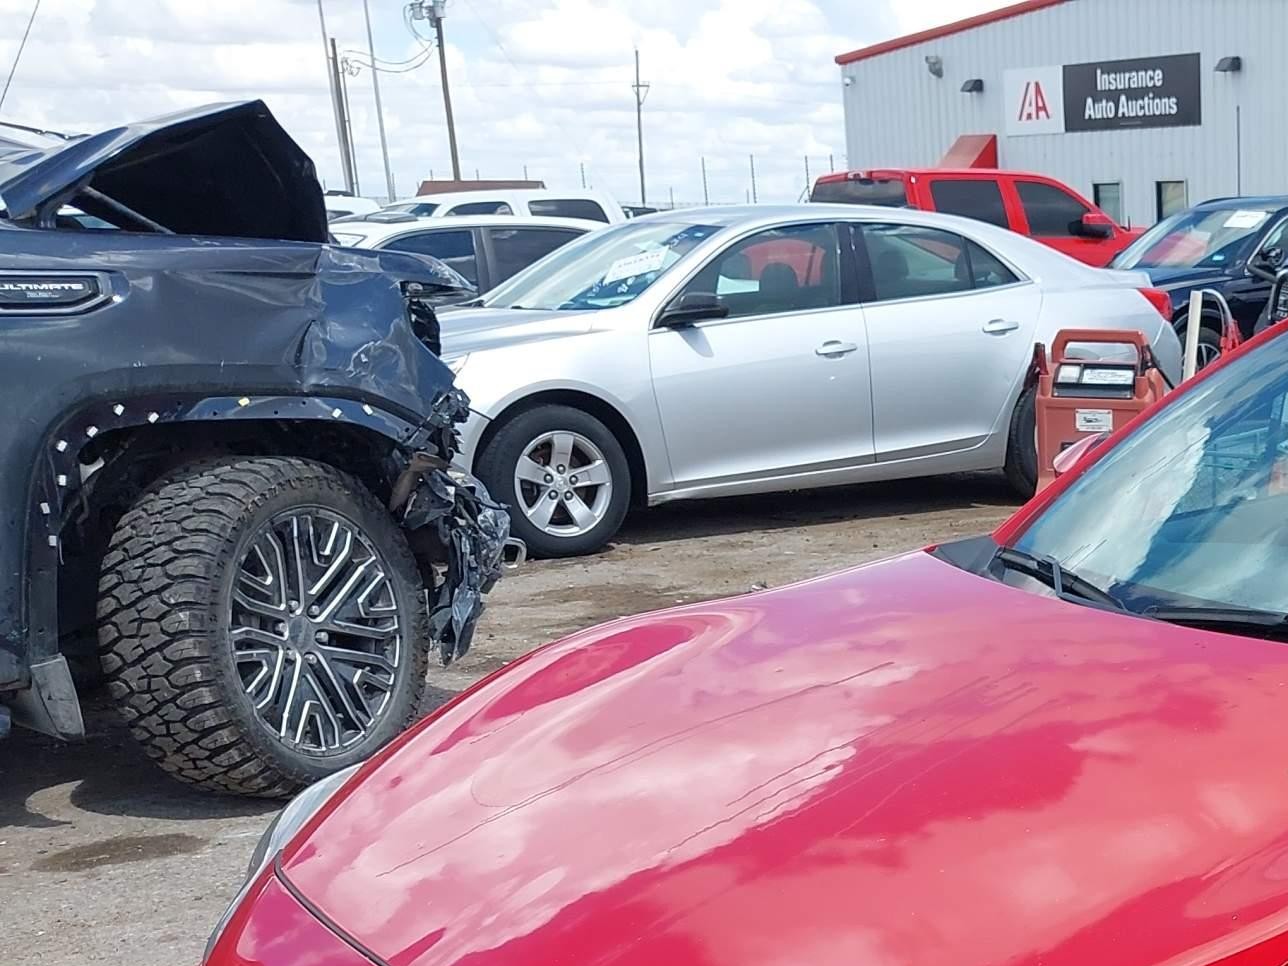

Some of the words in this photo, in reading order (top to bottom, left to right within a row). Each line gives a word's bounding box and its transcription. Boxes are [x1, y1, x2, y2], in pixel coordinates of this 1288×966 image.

[1096, 68, 1163, 91] Insurance
[1084, 97, 1115, 120] Auto
[1117, 93, 1178, 117] Auctions
